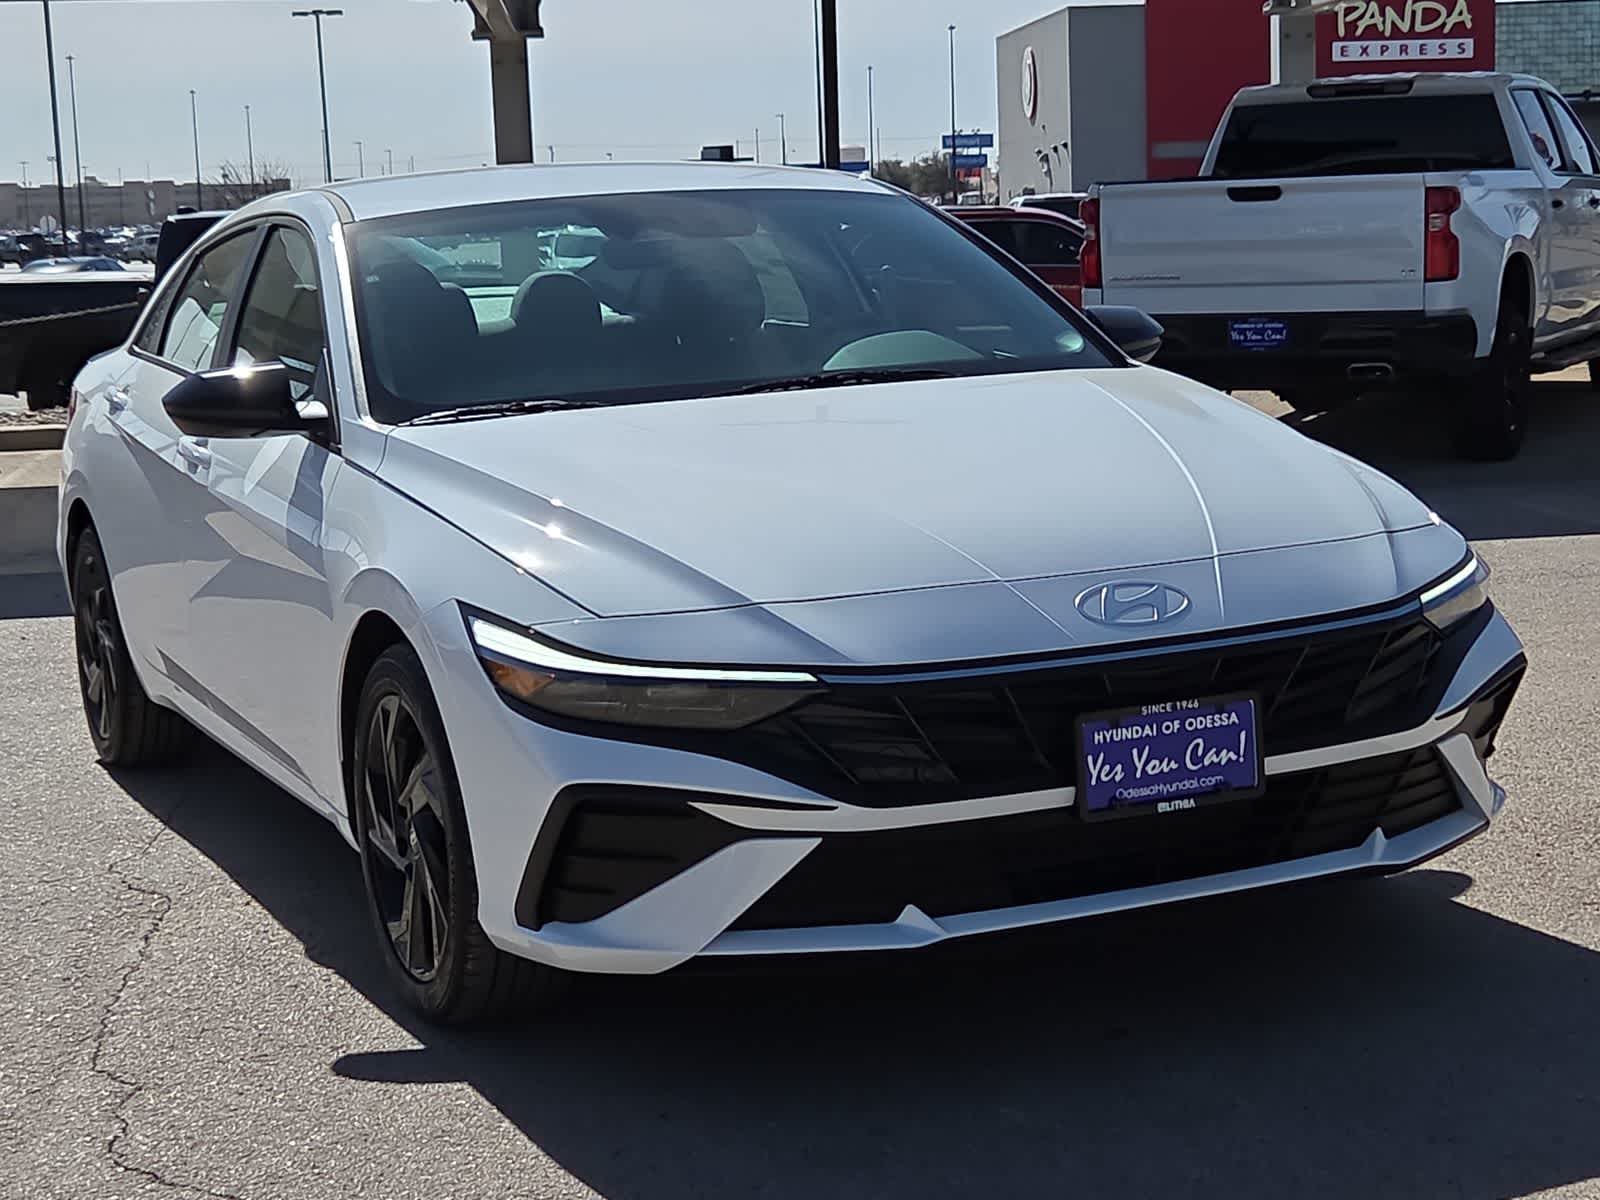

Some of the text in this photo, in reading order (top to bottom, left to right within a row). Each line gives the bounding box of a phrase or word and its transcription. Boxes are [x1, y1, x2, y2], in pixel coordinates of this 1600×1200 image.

[1334, 0, 1472, 38] PANDA
[1340, 42, 1467, 58] EXPRESS
[1141, 702, 1173, 716] SINCE
[1094, 711, 1240, 745] HYUNDAI OF ODESSA
[1087, 729, 1247, 786] Yes You Can!
[1116, 774, 1224, 800] OdessaHyundai.com
